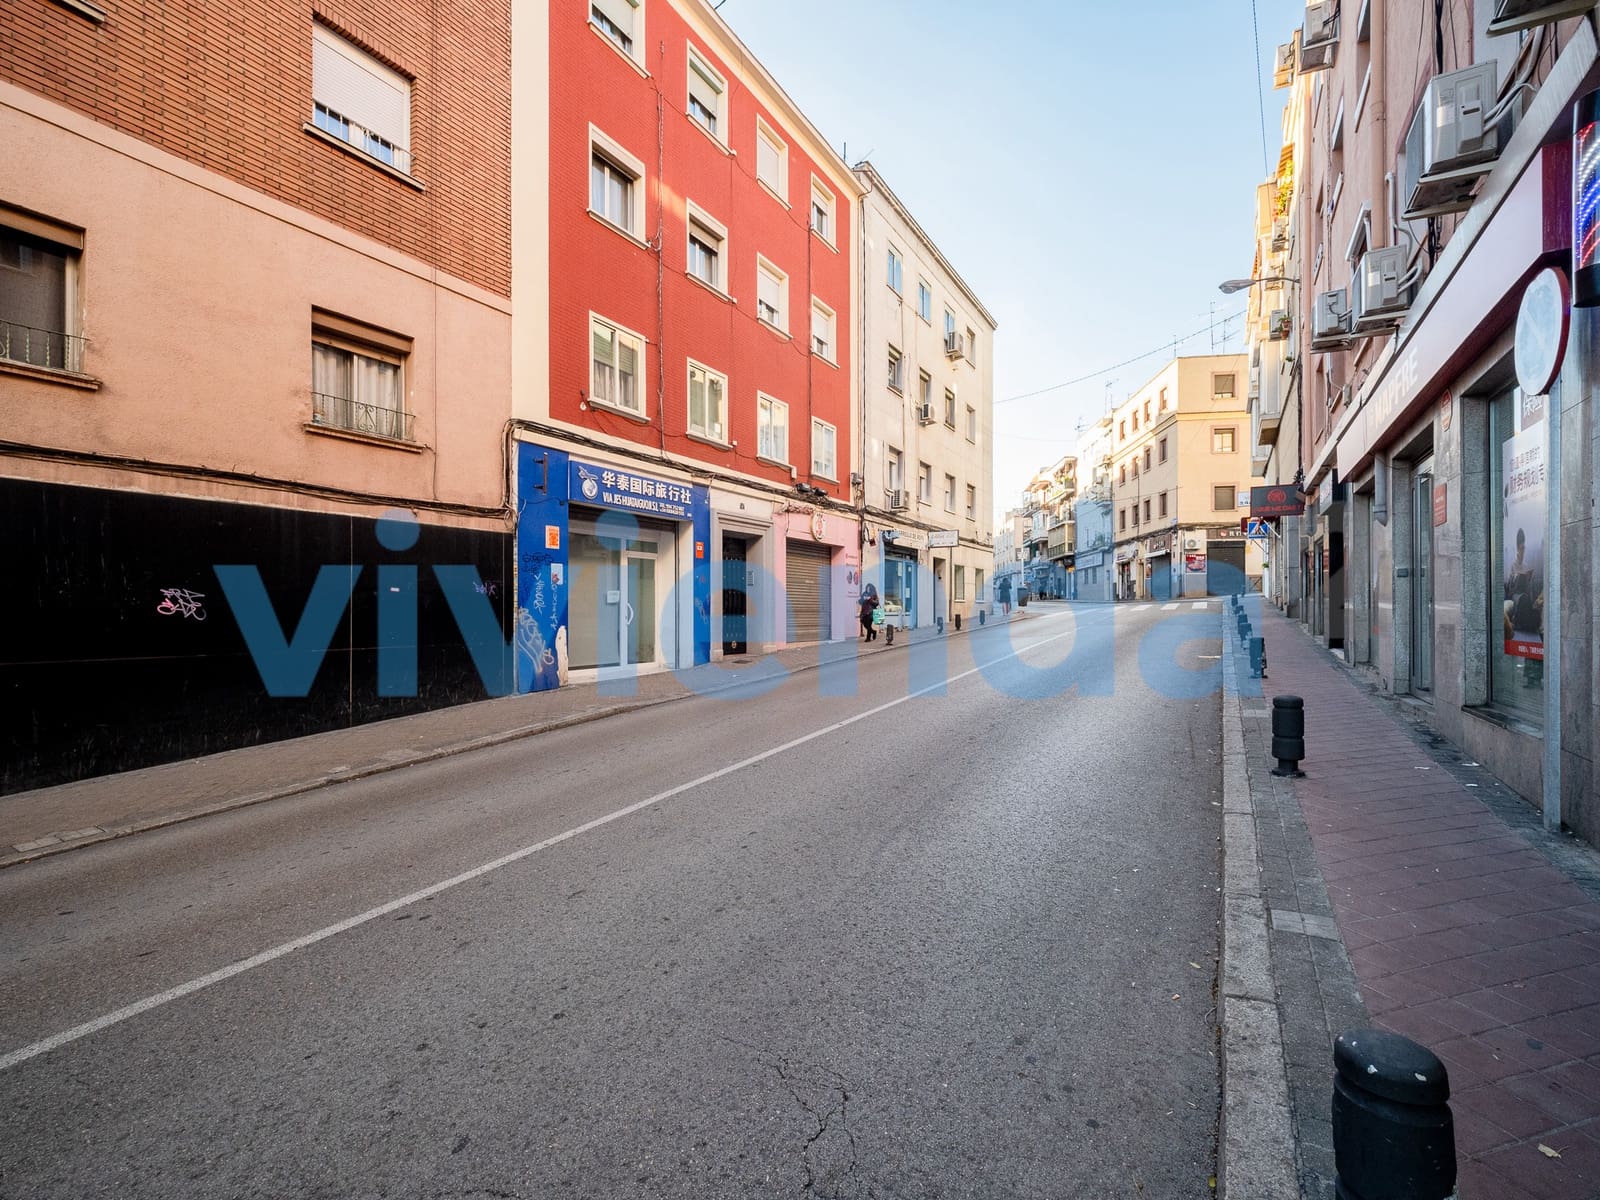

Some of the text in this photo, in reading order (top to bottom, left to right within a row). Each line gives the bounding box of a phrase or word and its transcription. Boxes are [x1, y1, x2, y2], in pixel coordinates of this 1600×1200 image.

[1375, 347, 1418, 428] MAPFRE
[602, 470, 692, 505] 华泰国际旅行社
